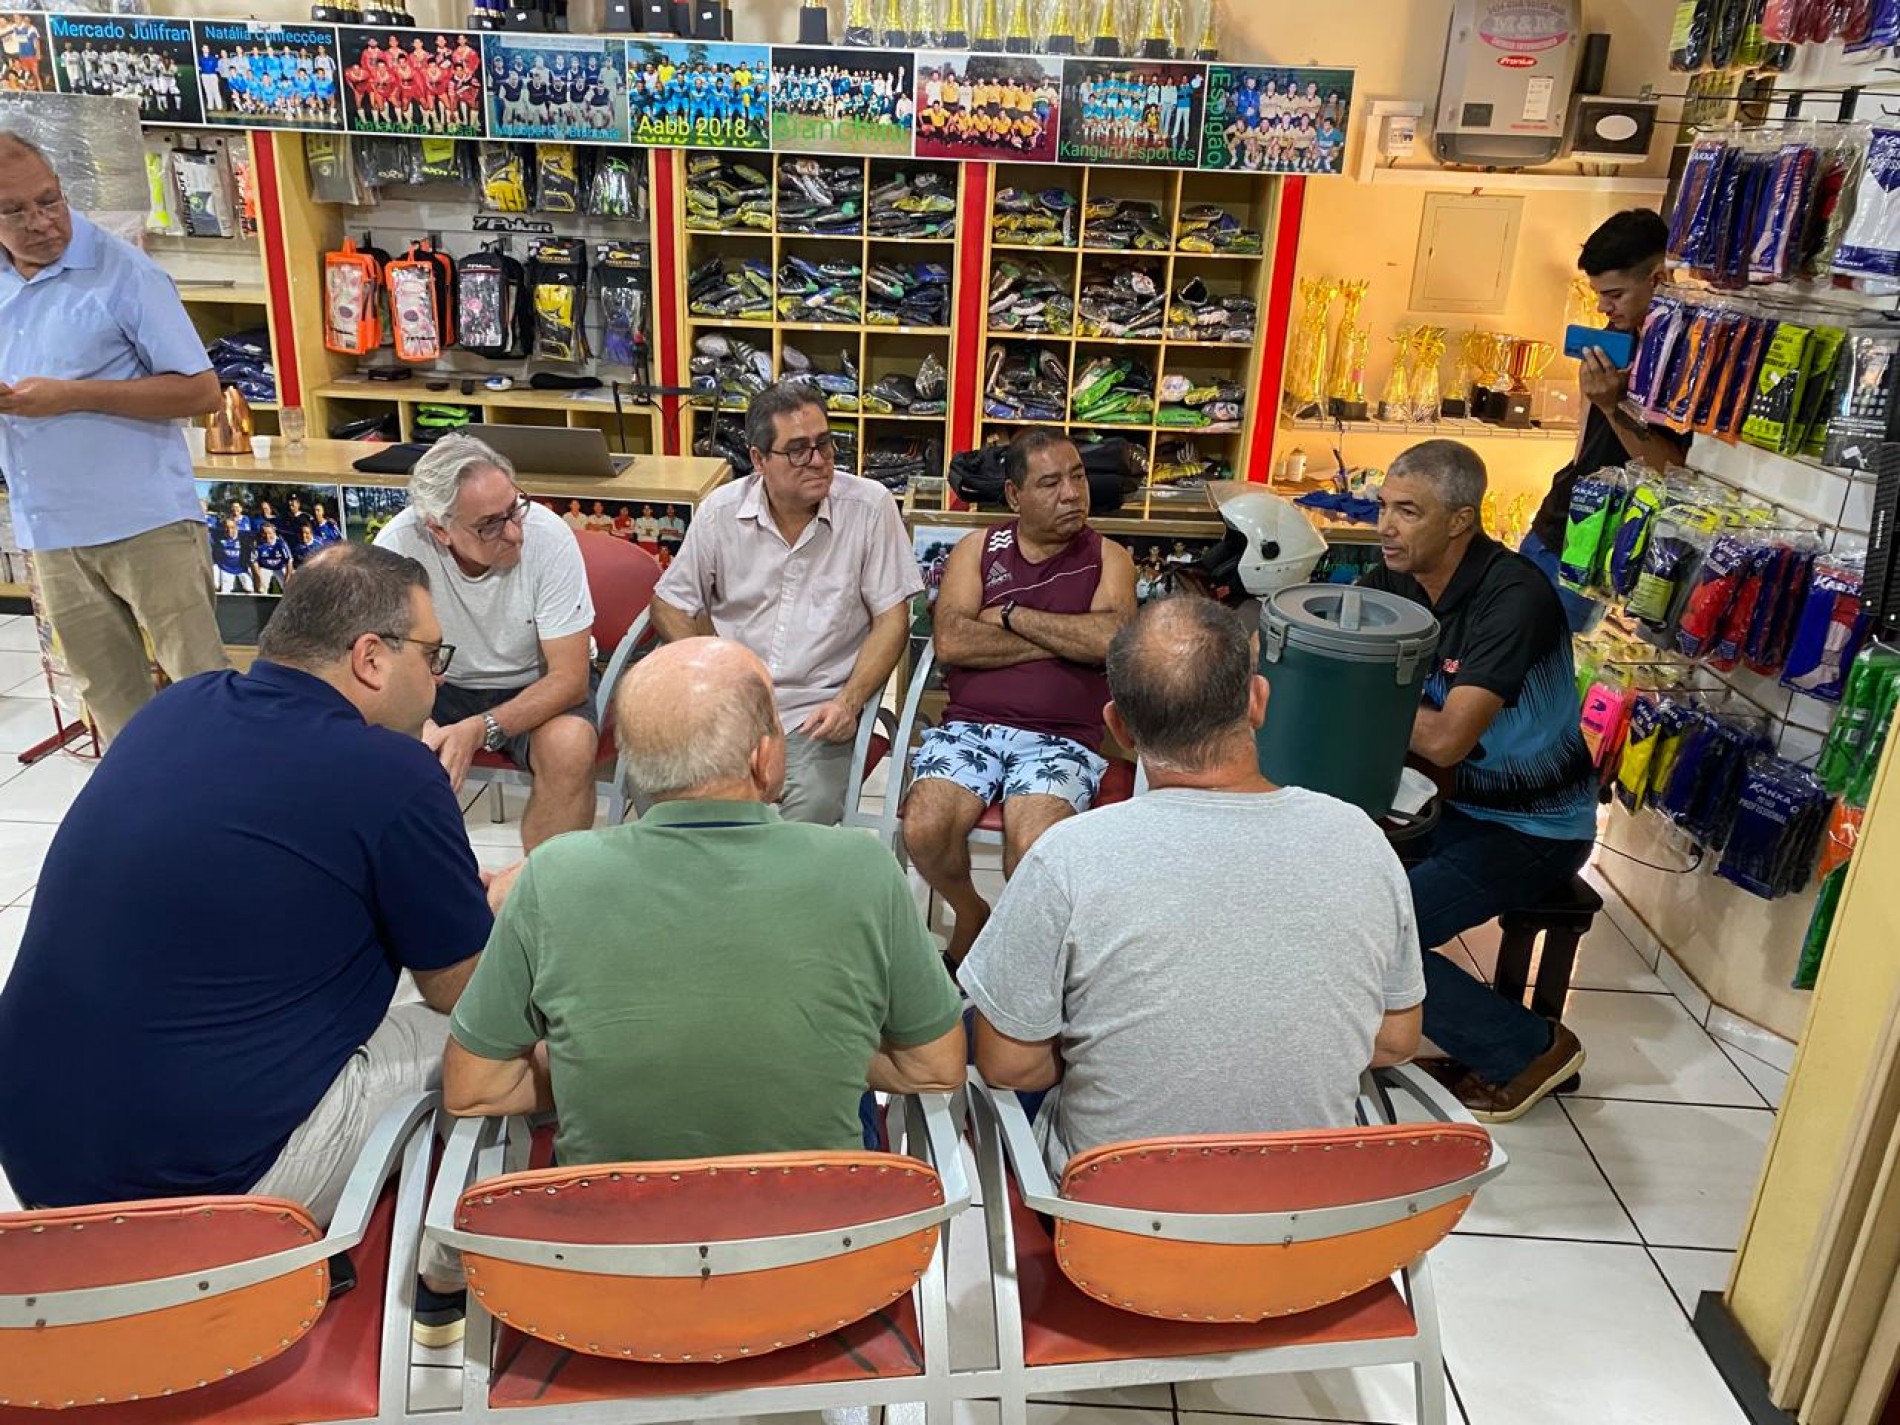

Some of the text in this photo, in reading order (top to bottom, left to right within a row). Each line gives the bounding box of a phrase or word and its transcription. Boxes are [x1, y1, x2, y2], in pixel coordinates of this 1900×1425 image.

[52, 19, 191, 41] Mercado Julifran
[205, 25, 251, 40] Natália
[638, 115, 690, 136] Aabb
[696, 116, 747, 139] 2018
[1205, 73, 1231, 164] Espigão
[1060, 140, 1196, 163] Kanguru Esportes
[1748, 781, 1792, 805] KANXA
